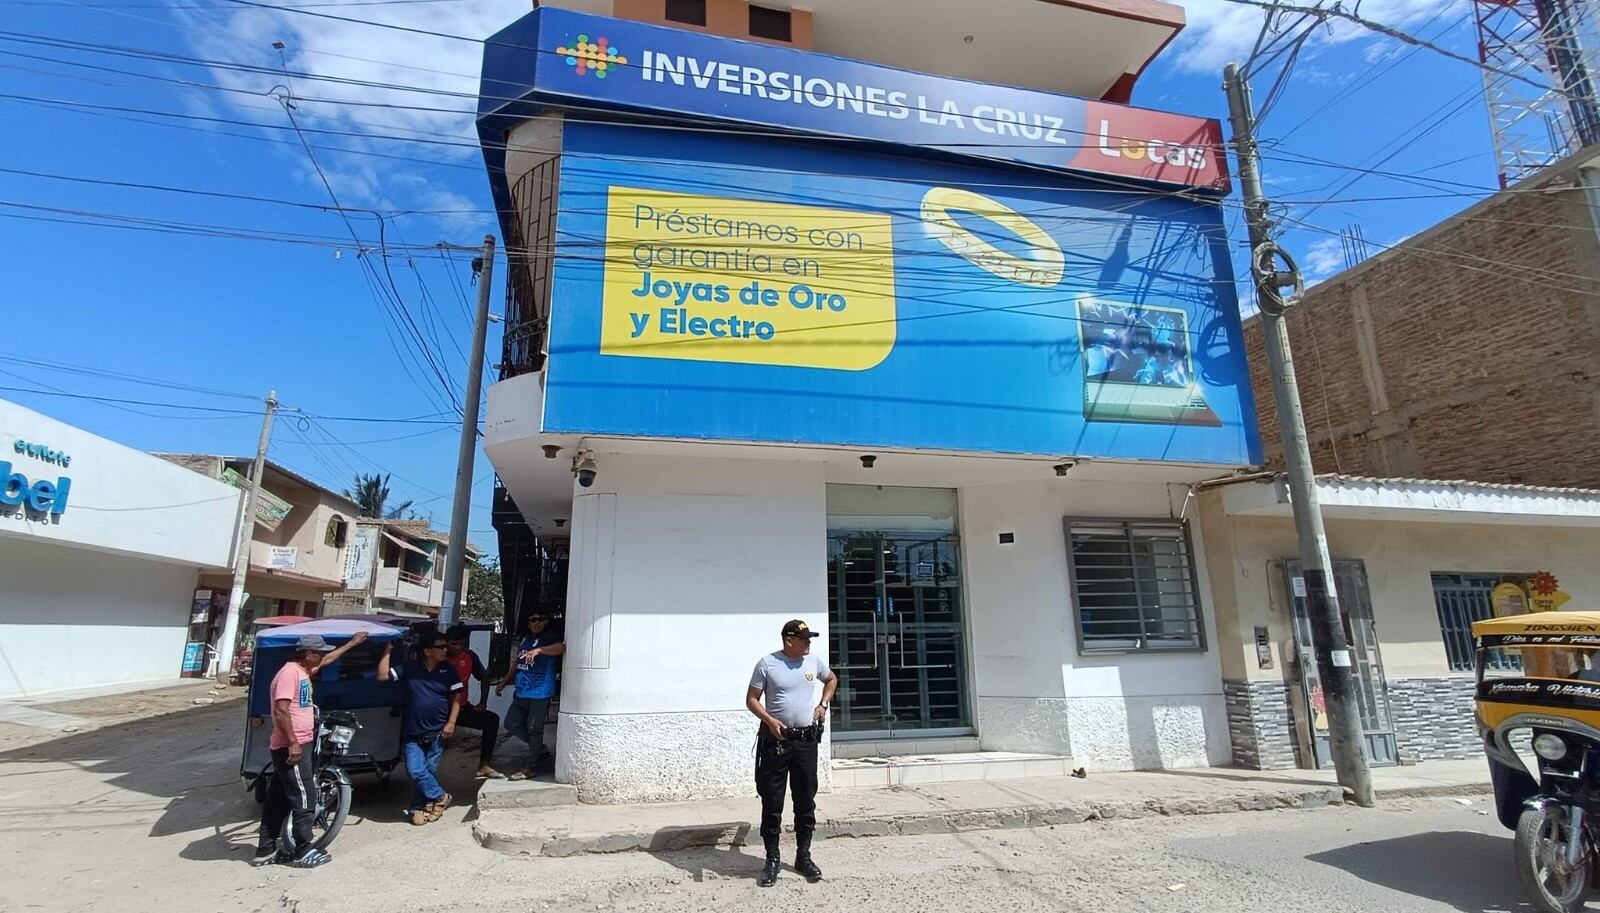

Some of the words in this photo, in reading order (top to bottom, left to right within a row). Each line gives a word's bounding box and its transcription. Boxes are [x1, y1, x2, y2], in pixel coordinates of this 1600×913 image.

[642, 50, 908, 119] INVERSIONES
[918, 95, 965, 130] LA
[971, 105, 1067, 145] CRUZ
[1099, 119, 1206, 170] Lucas
[634, 204, 799, 243] Préstamos
[808, 228, 863, 250] con
[633, 243, 772, 273] garantía
[783, 256, 820, 277] en
[632, 272, 730, 305] Joyas
[739, 281, 780, 306] de
[788, 284, 847, 311] Oro
[630, 313, 651, 338] y
[660, 308, 775, 340] Electro
[1523, 624, 1597, 632] ZONGSHEN
